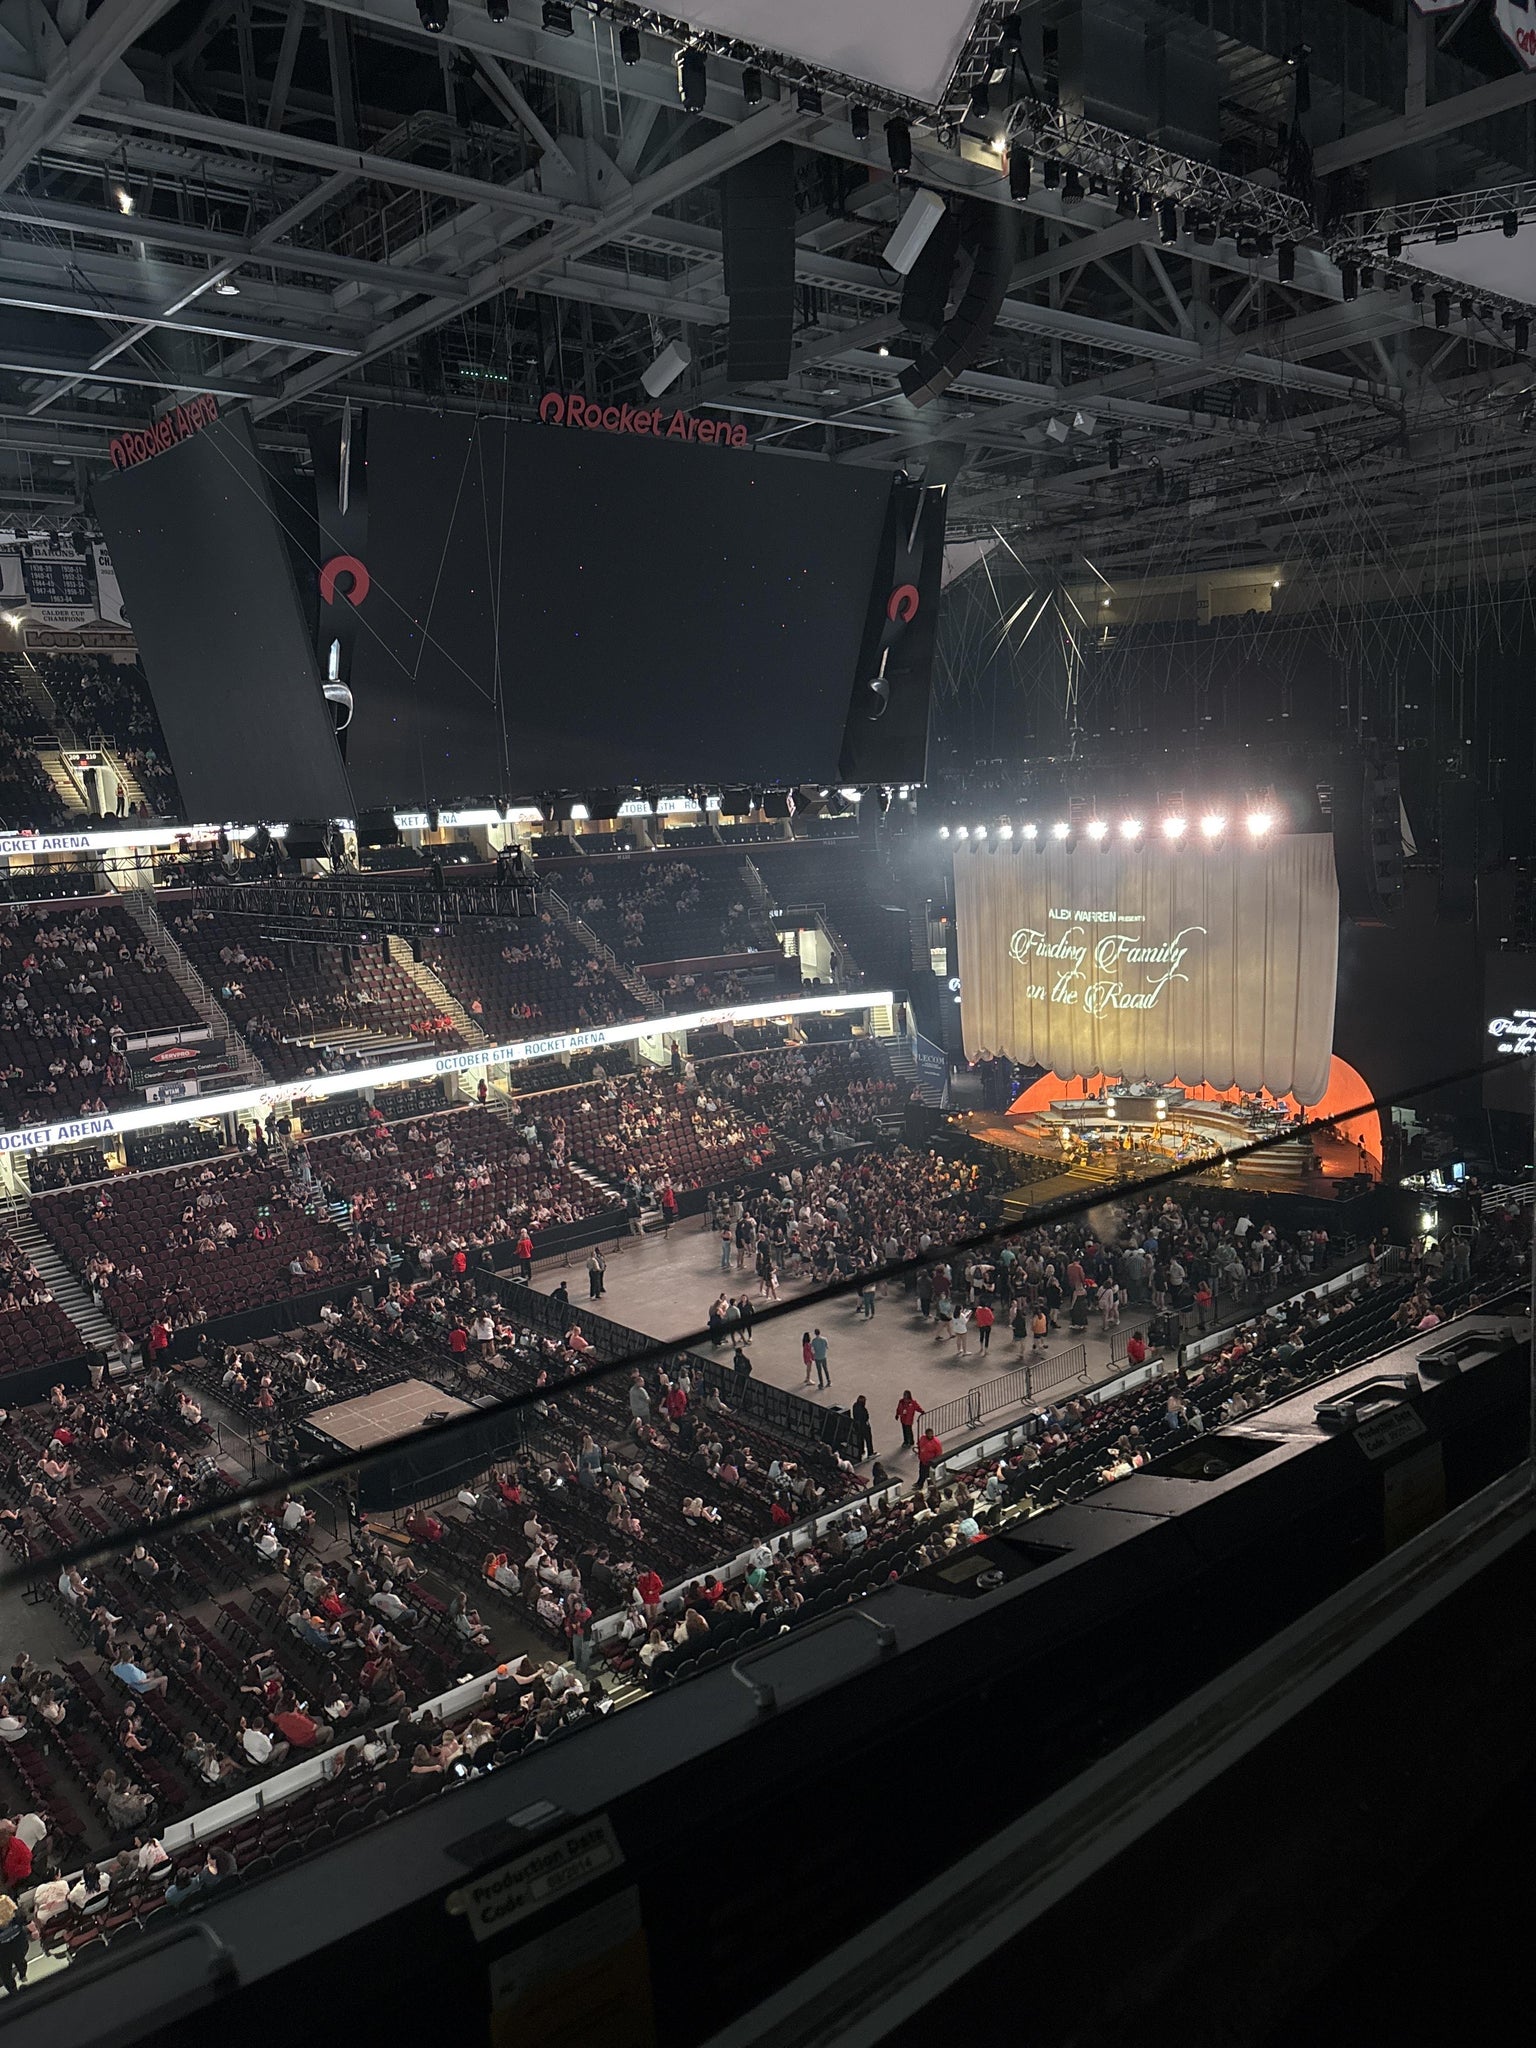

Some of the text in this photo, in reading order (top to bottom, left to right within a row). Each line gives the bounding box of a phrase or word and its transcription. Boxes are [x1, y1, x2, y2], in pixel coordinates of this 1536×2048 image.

[121, 393, 219, 466] Rocket Arena
[567, 394, 748, 447] Rocket Arena
[42, 836, 90, 850] ARENA
[1073, 910, 1117, 922] WARREN
[1009, 926, 1206, 978] Finding Family
[1026, 971, 1174, 1020] on the Road
[161, 1050, 191, 1061] SERVPRO
[436, 1032, 606, 1072] OCTOBER 6TH ROCKET ARENA
[918, 1053, 945, 1065] LECOM
[0, 1118, 114, 1151] OCKET ARENA
[473, 1829, 606, 1904] Production Date
